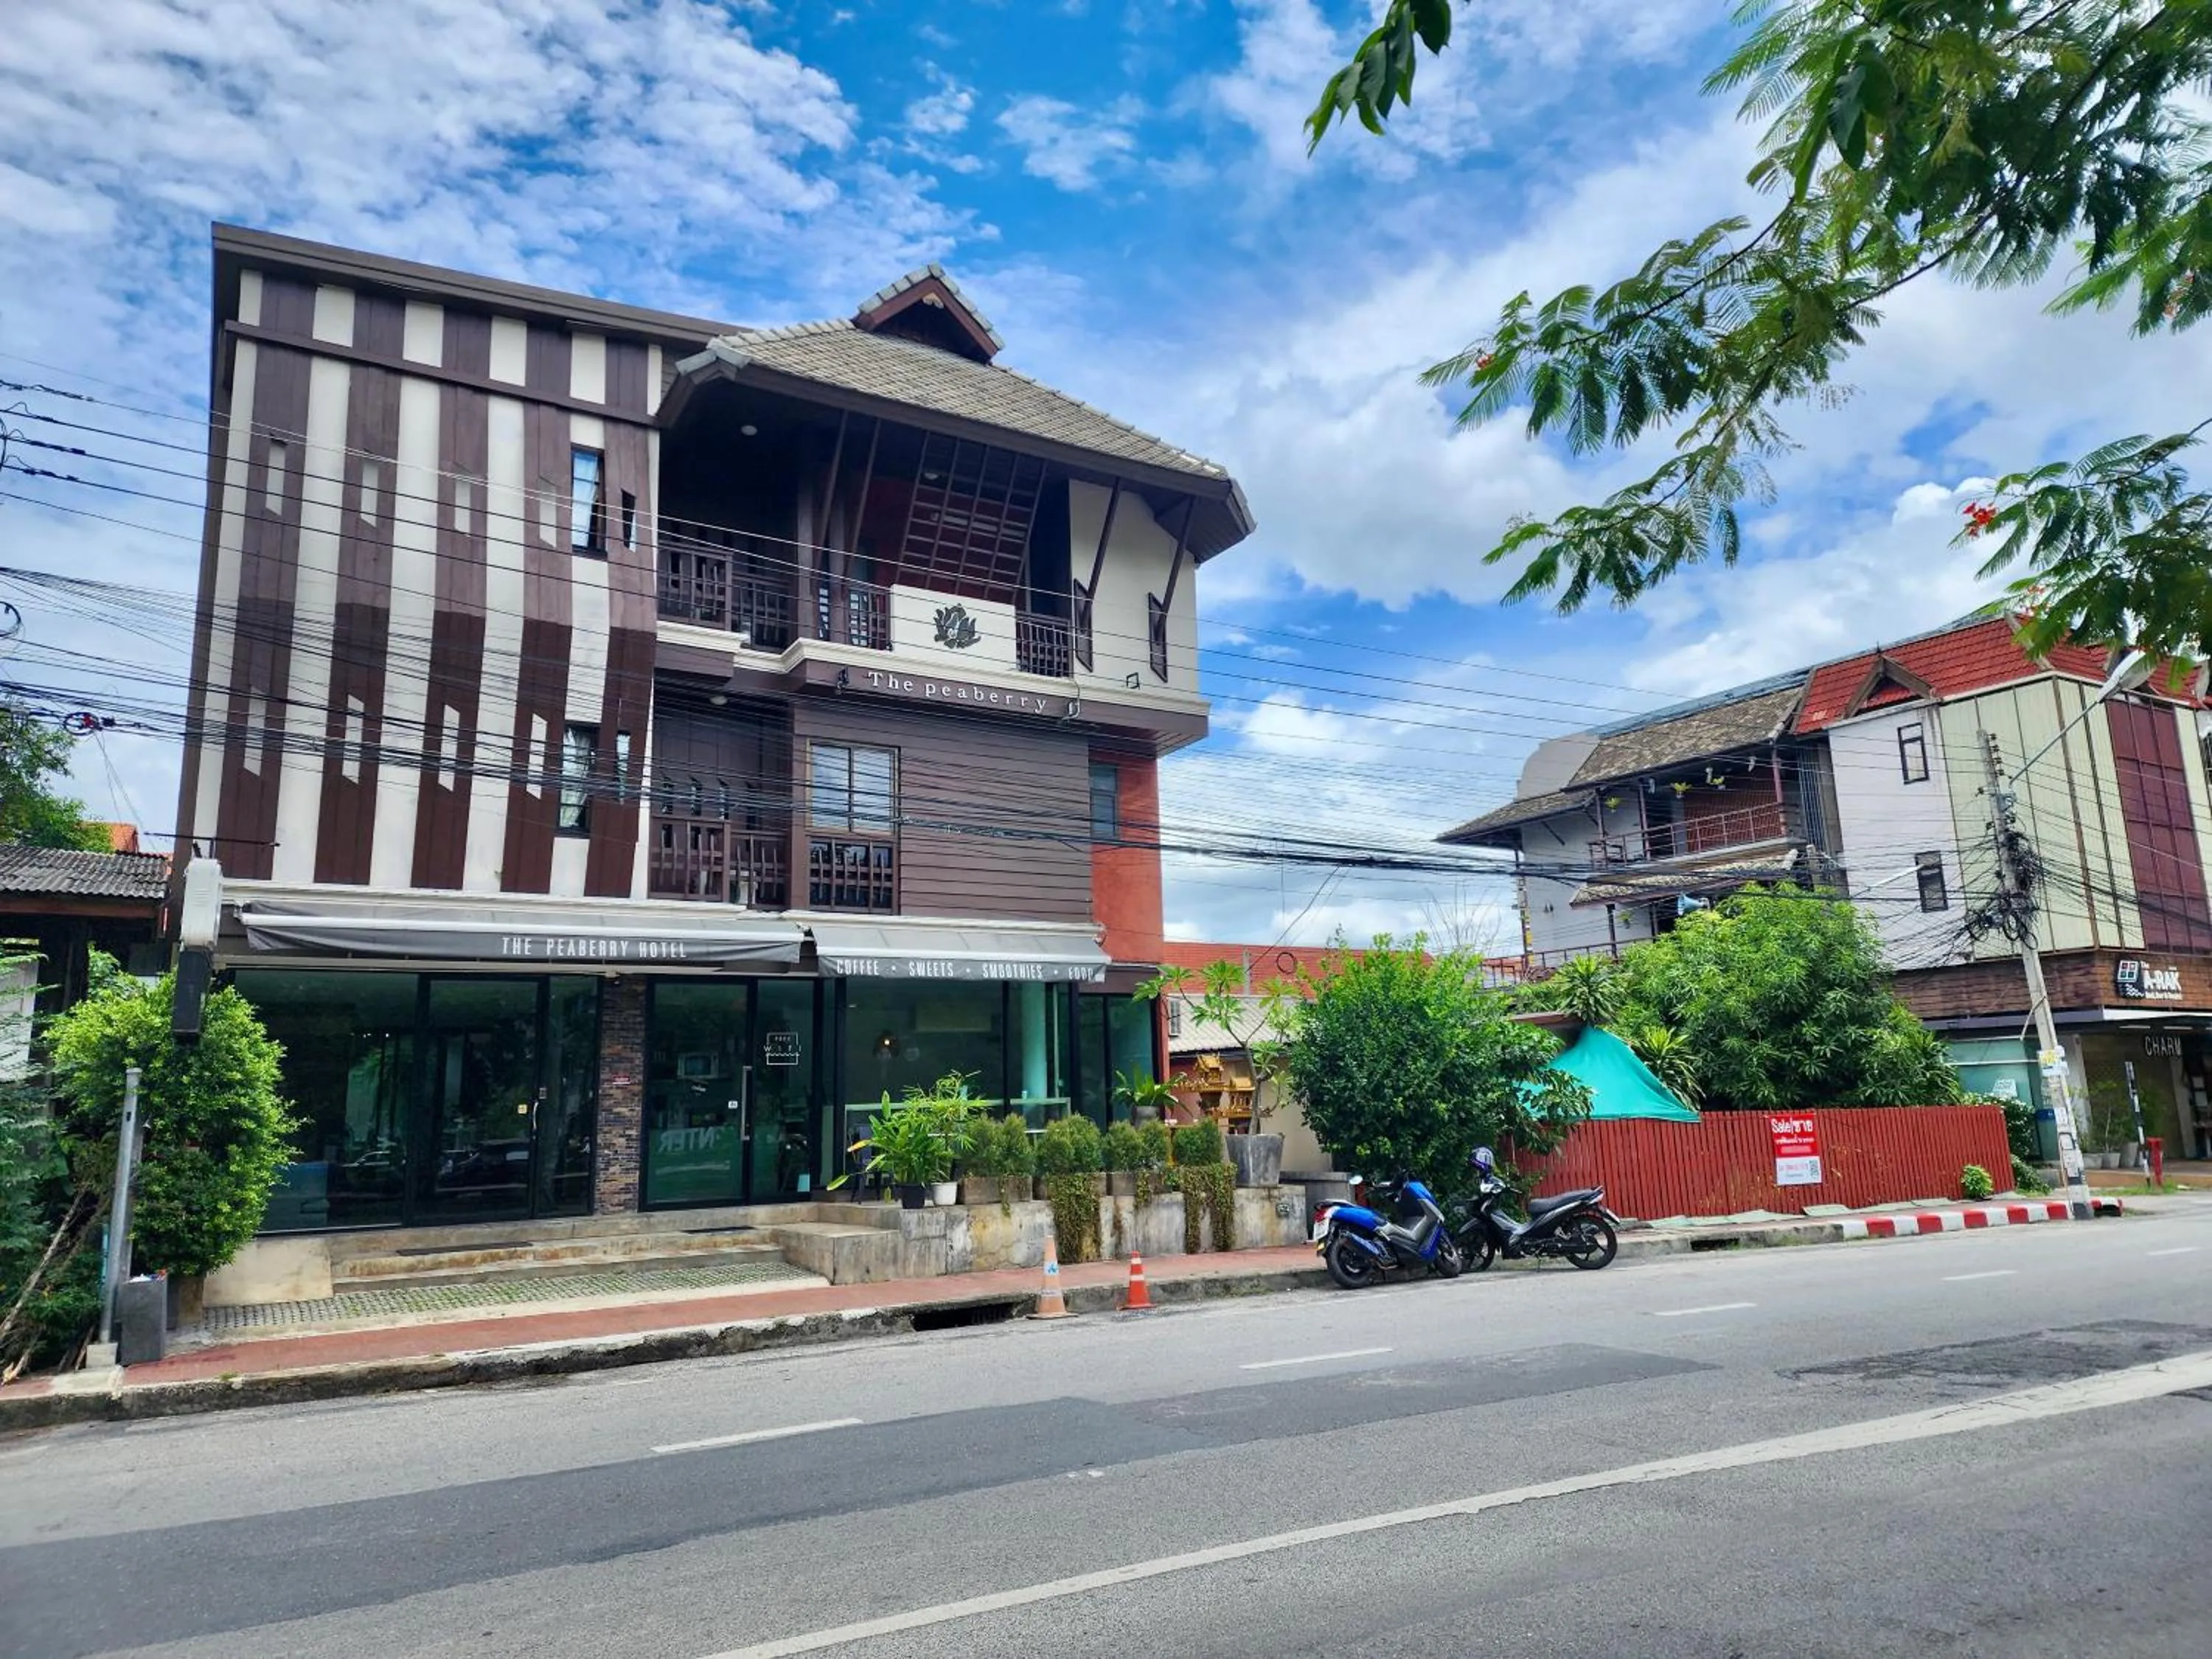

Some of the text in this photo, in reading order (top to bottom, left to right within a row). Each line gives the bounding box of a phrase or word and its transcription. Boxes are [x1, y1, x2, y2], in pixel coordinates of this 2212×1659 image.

[868, 671, 1047, 713] The peaberry
[502, 937, 686, 958] THE PEABERRY HOTEL
[837, 959, 880, 975] COFFEE
[908, 961, 954, 977] SWEETS
[981, 962, 1043, 978] SMOOTHIES
